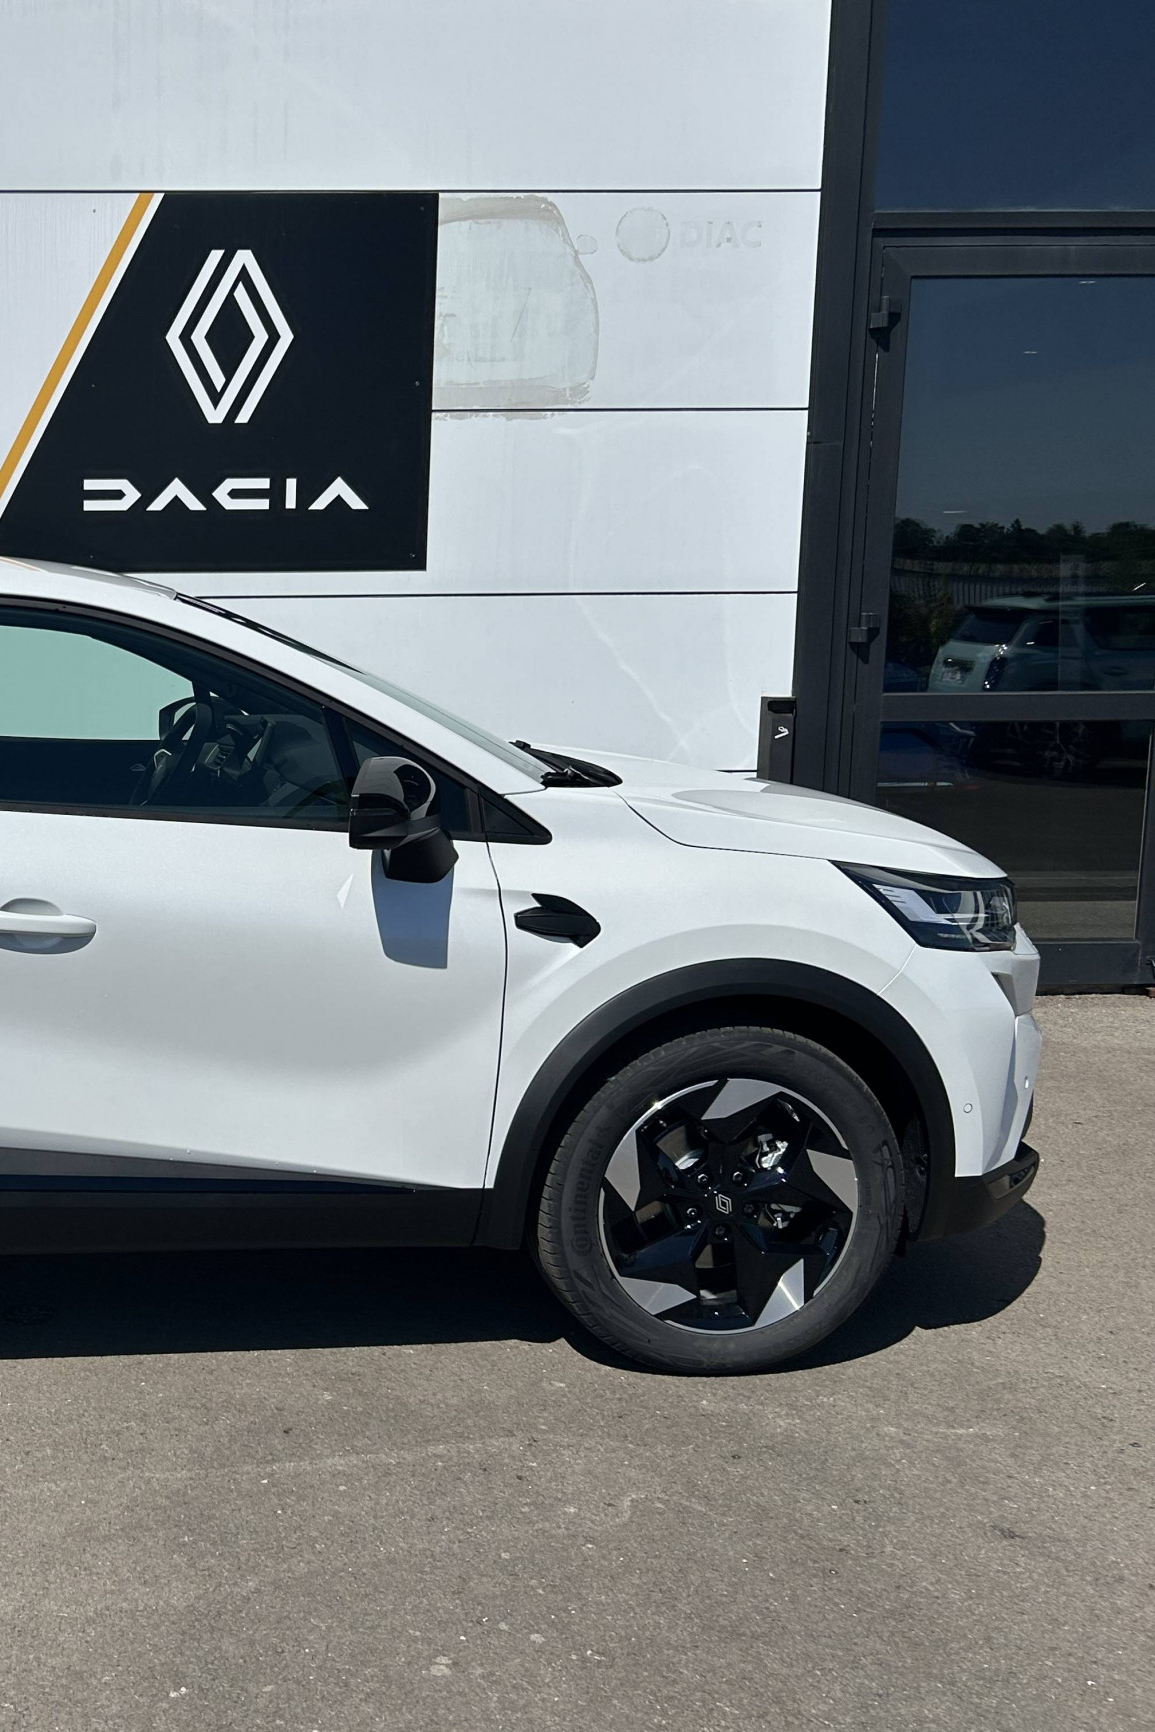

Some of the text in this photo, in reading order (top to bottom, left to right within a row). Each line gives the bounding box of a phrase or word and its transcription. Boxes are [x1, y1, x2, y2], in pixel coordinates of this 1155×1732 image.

[680, 220, 762, 249] DIAC
[83, 476, 370, 511] DACIA
[569, 1137, 605, 1257] Continental
